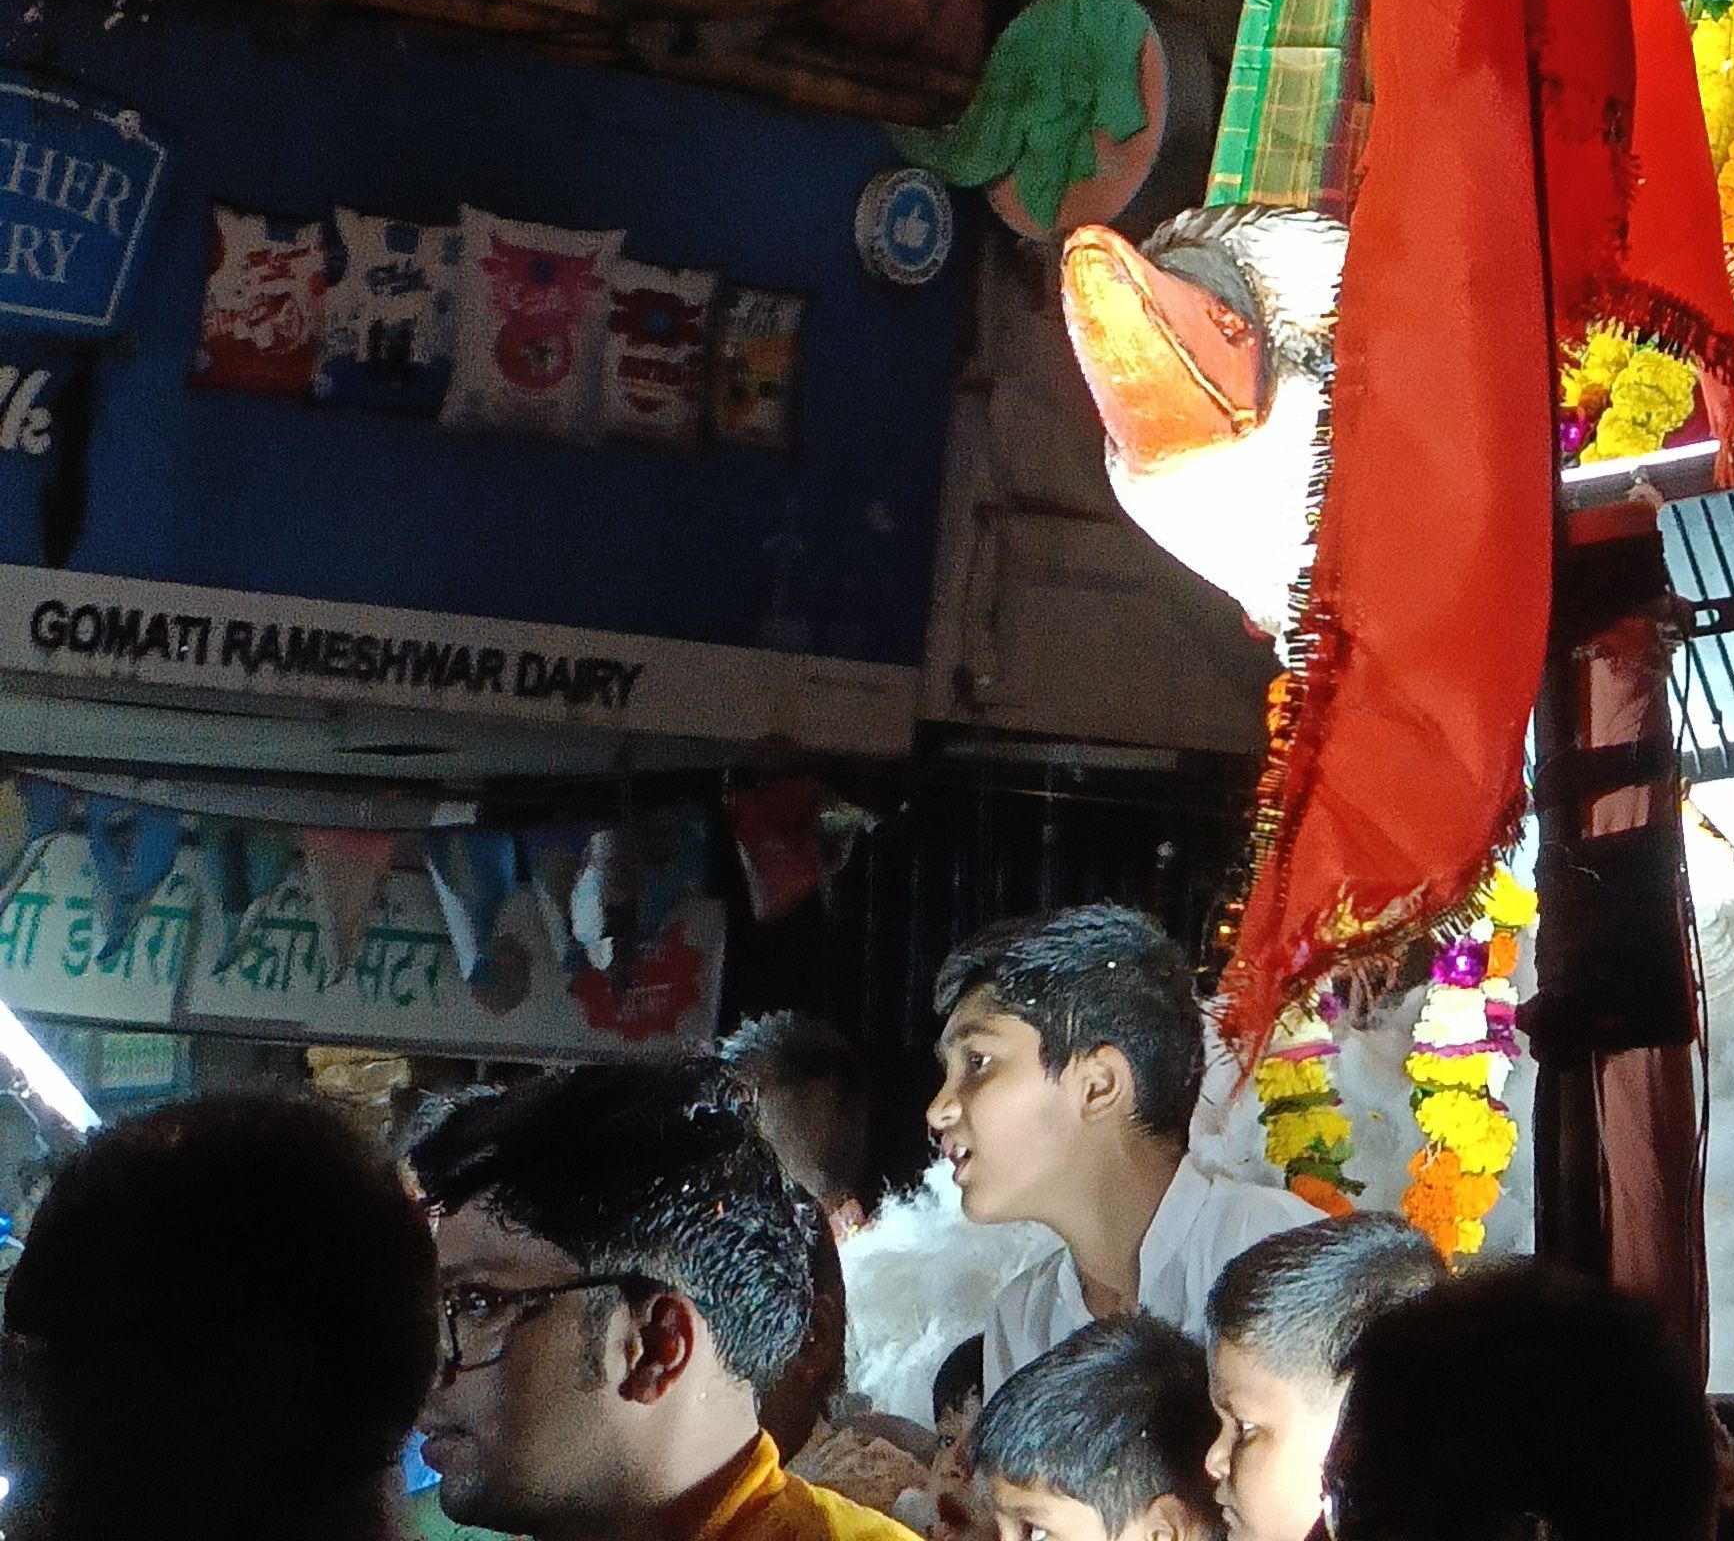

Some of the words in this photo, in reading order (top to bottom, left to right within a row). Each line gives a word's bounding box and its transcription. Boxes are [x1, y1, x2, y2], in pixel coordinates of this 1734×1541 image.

[30, 600, 211, 666] GOMATI
[222, 619, 504, 694] RAMESHWAR
[515, 650, 642, 708] DAIRY
